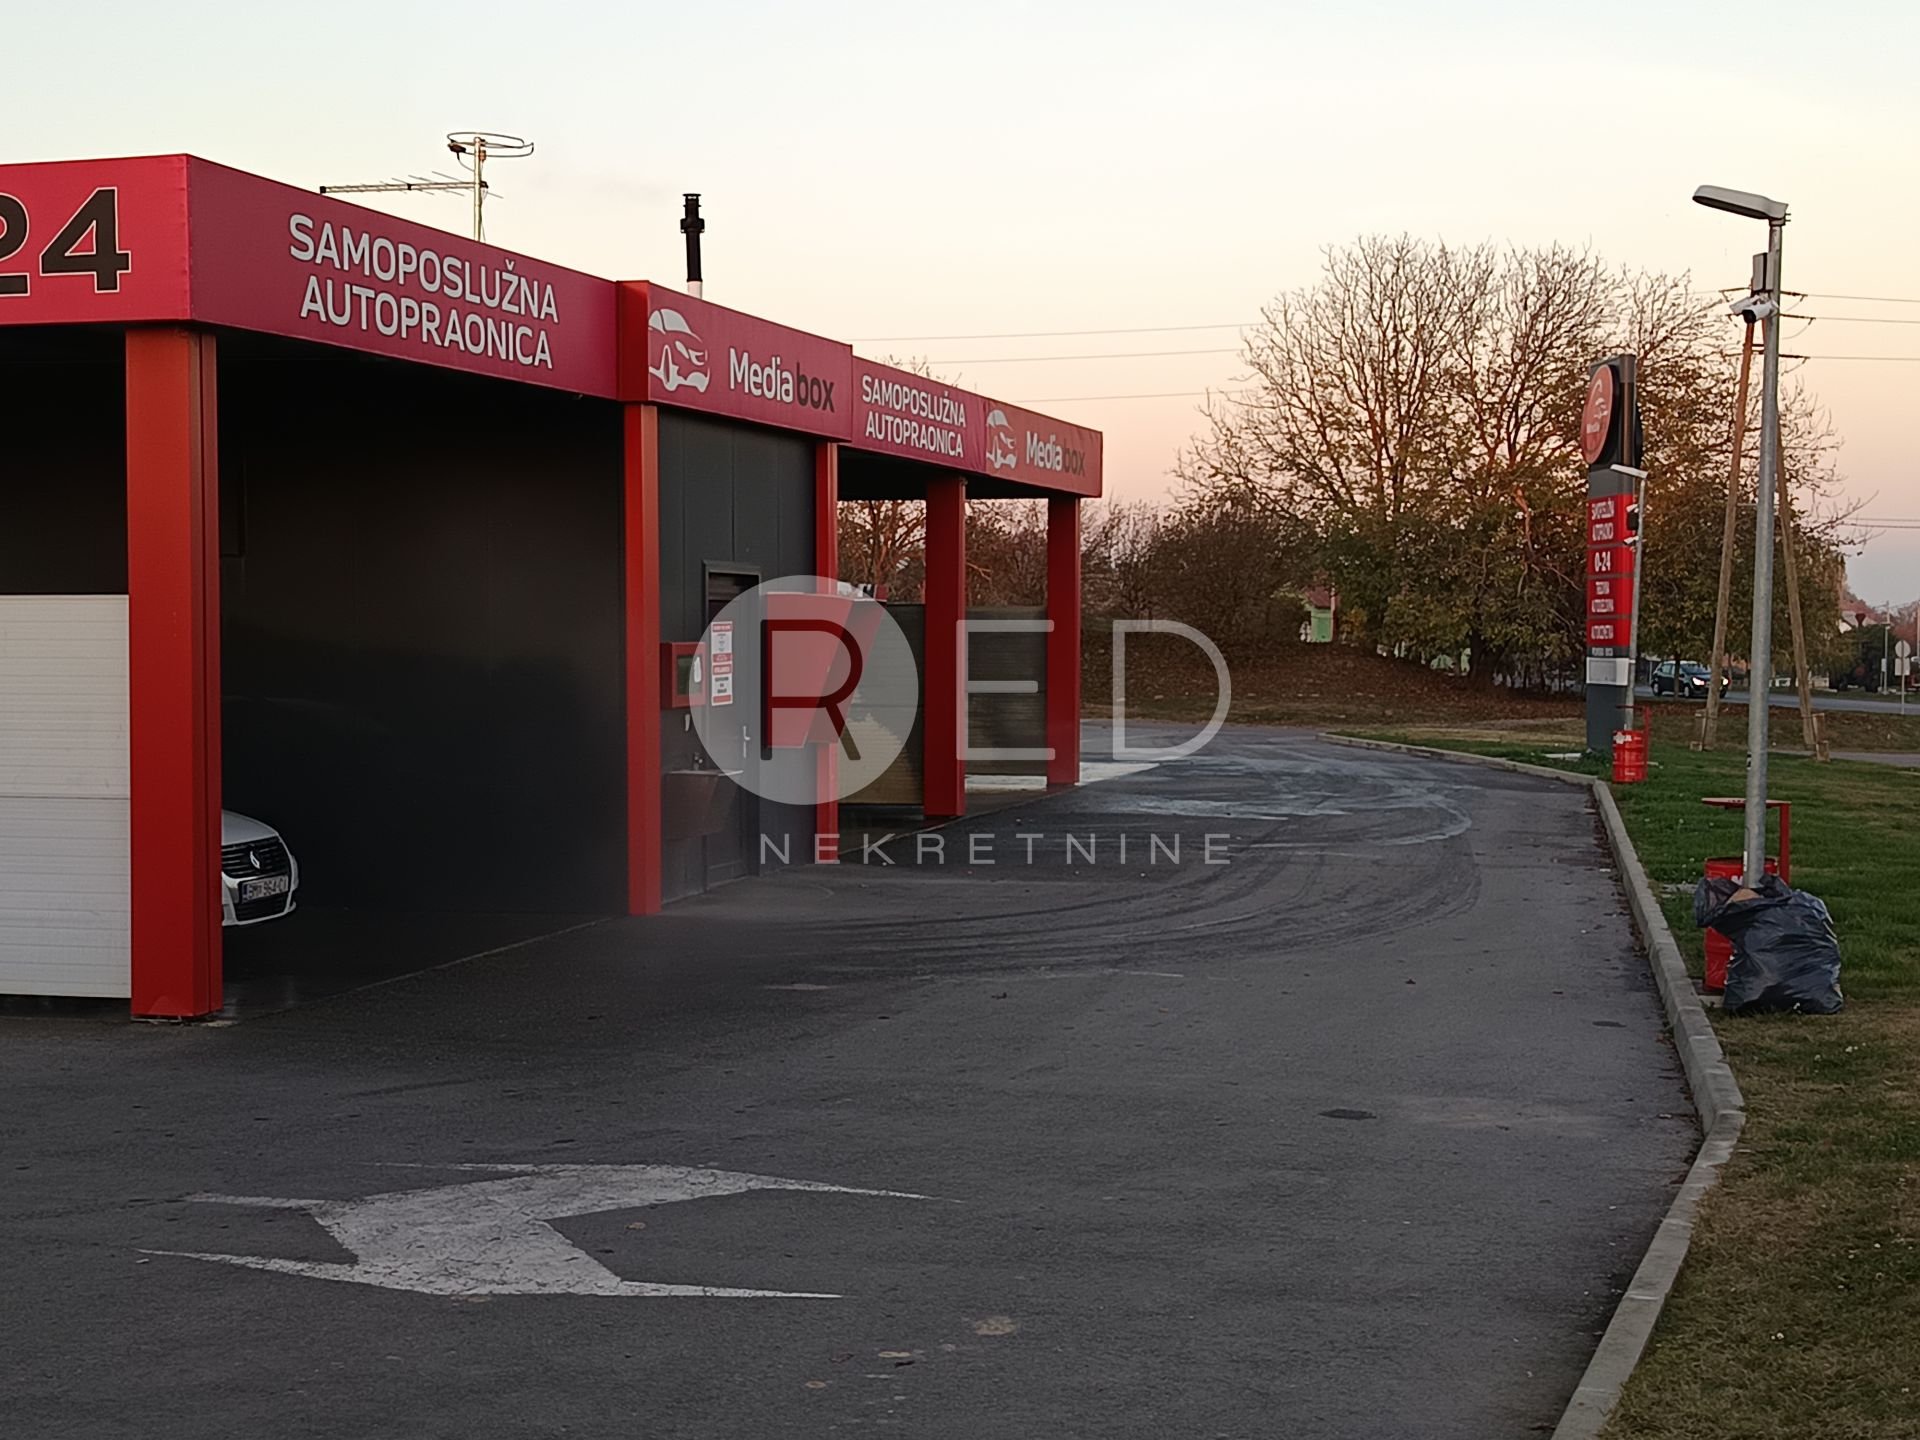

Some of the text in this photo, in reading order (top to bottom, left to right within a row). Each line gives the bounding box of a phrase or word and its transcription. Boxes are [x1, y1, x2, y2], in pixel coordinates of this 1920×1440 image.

[289, 213, 558, 323] SAMOPOSLUŽNA
[300, 275, 553, 369] AUTOPRAONICA
[861, 374, 967, 428] SAMOPOSLUŽNA
[865, 410, 964, 459] AUTOPRAONICA
